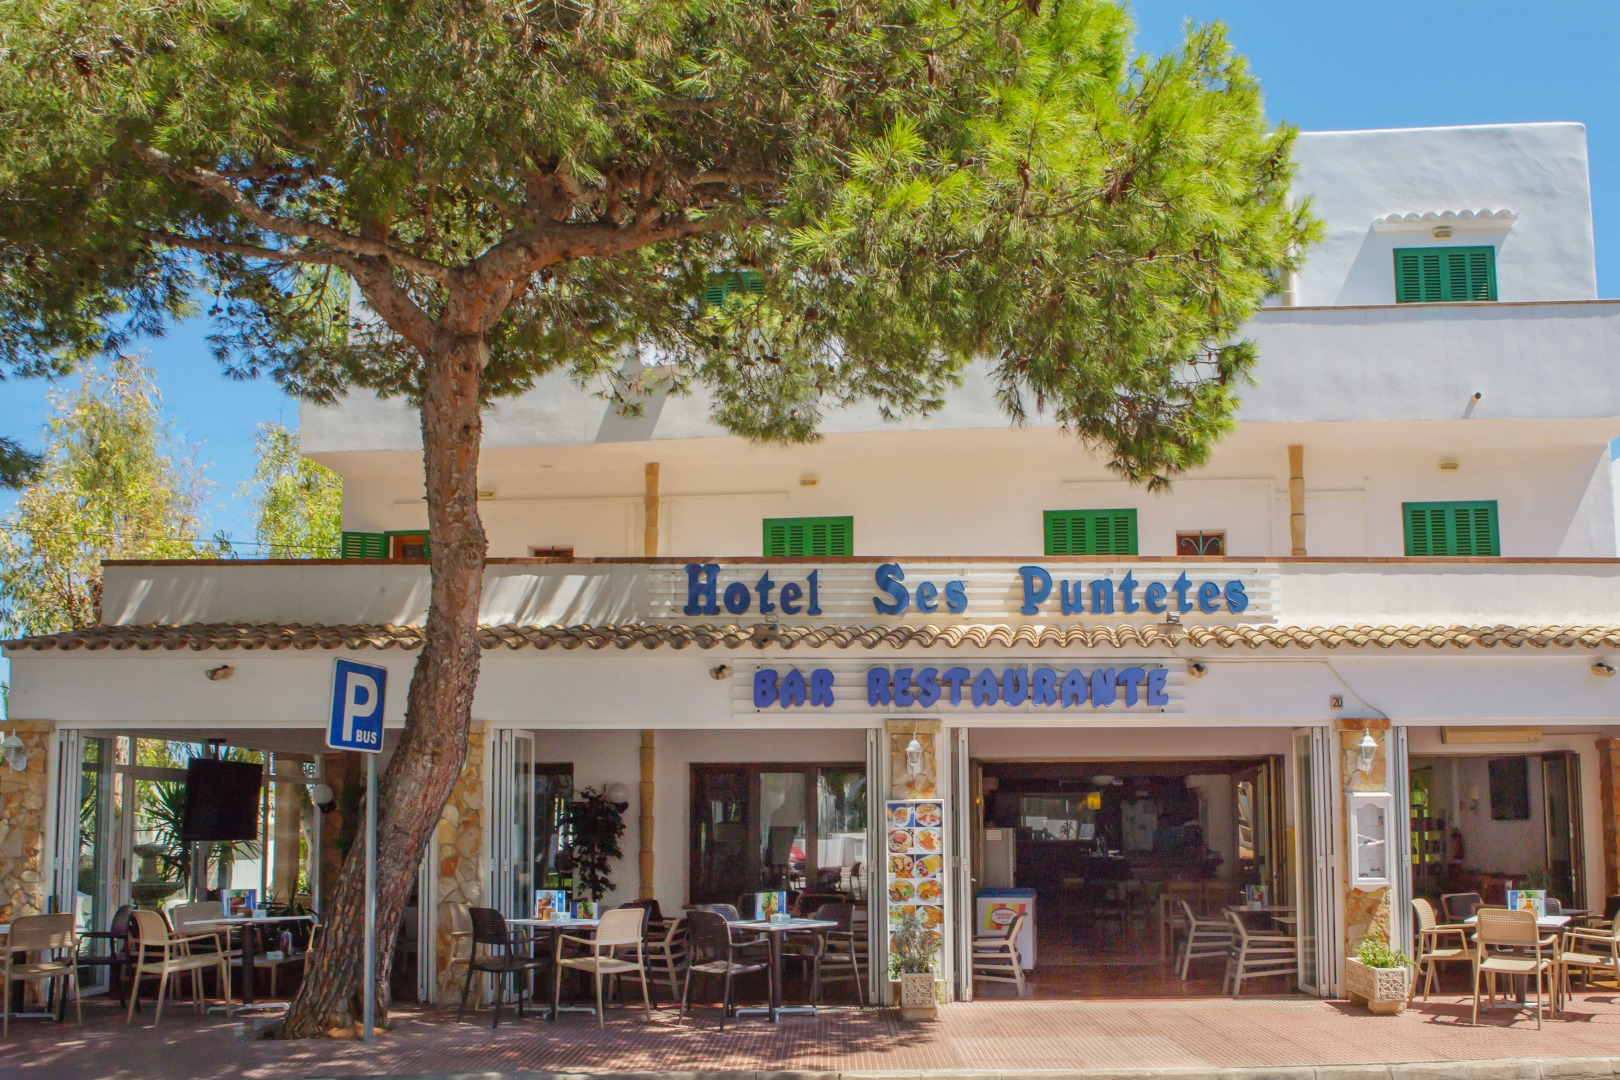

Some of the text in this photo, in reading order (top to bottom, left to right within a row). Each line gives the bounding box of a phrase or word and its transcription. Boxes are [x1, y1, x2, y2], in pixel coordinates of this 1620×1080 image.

[683, 562, 1249, 616] Hotel Ses Puntetes
[342, 672, 378, 741] P
[753, 666, 1169, 709] BAR RESTAURANTE
[1332, 696, 1343, 708] 20
[356, 729, 377, 744] BUS
